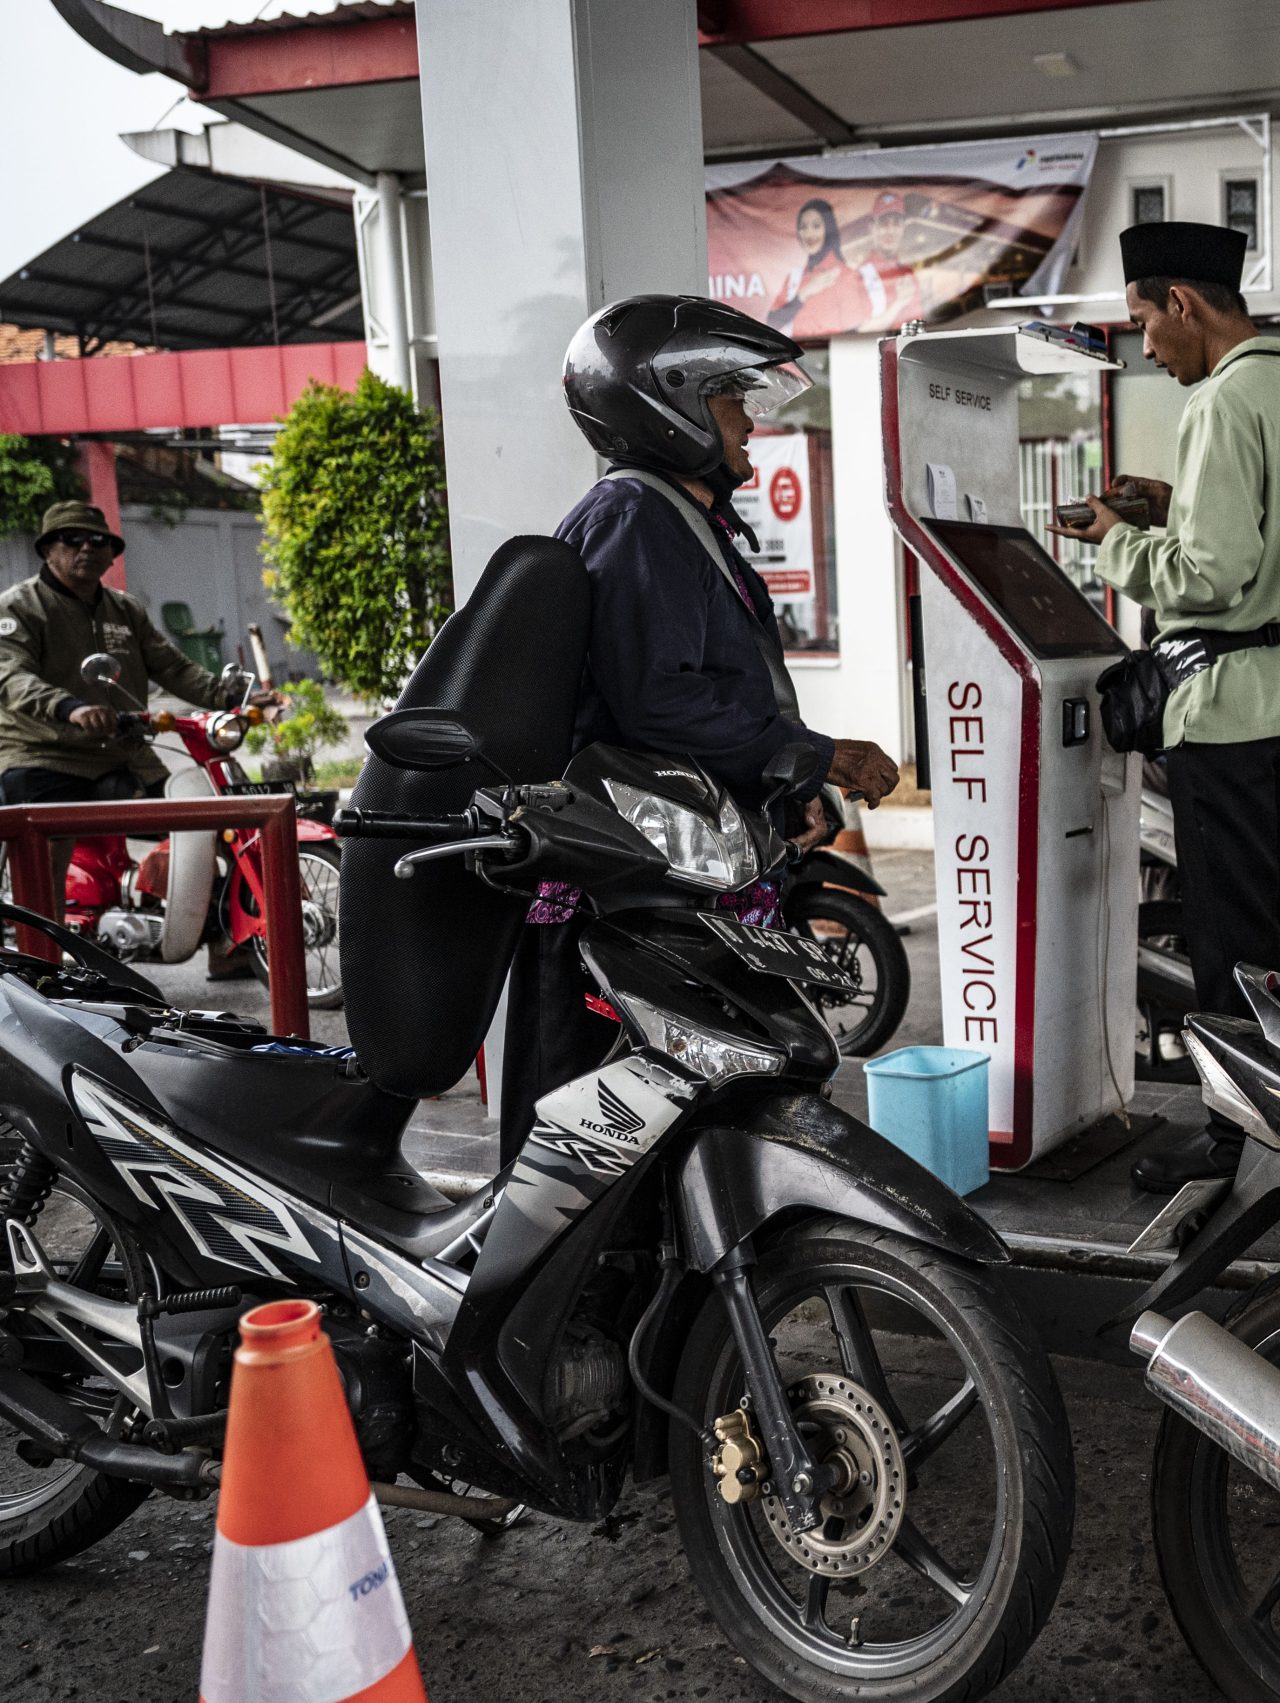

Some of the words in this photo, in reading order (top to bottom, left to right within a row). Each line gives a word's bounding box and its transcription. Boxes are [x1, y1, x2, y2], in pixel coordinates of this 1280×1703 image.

[929, 383, 951, 401] SELF
[955, 389, 992, 411] SERVICE
[947, 681, 987, 803] SELF
[653, 770, 702, 782] HONDA
[741, 925, 799, 956] 4437
[955, 833, 998, 1044] SERVICE
[579, 1117, 641, 1146] HONDA
